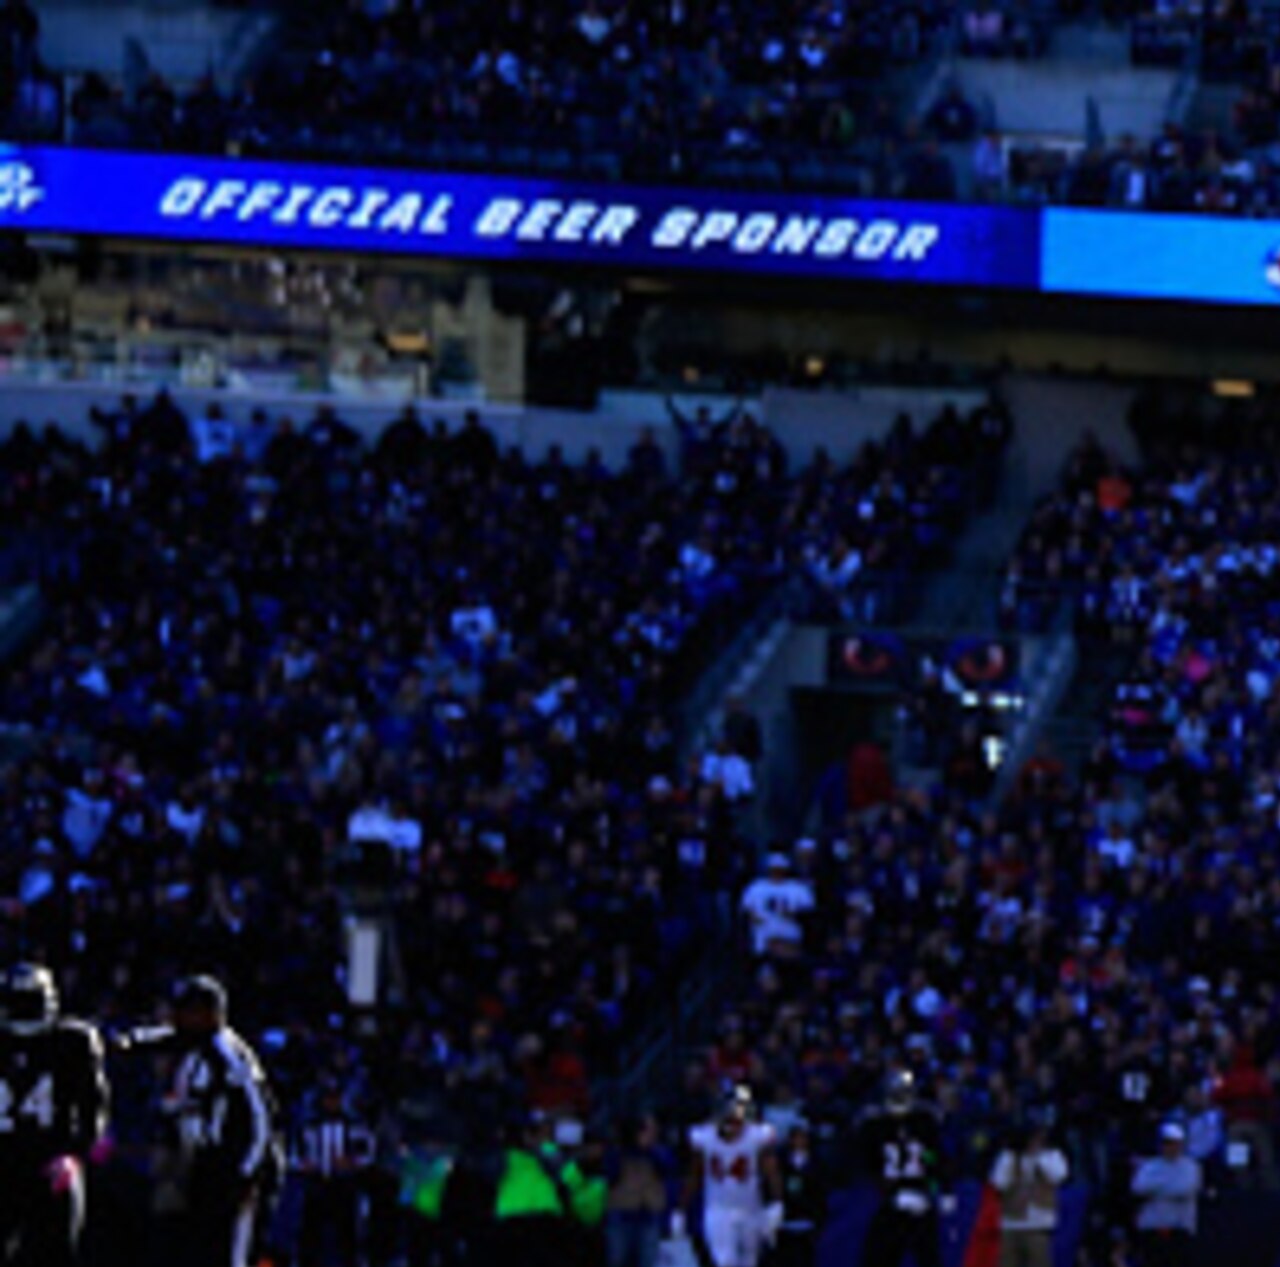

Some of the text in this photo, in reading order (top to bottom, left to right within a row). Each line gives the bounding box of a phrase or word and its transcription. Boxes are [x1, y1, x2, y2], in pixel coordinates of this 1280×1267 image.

[160, 177, 940, 262] OFFICIAL BEER SPONSOR
